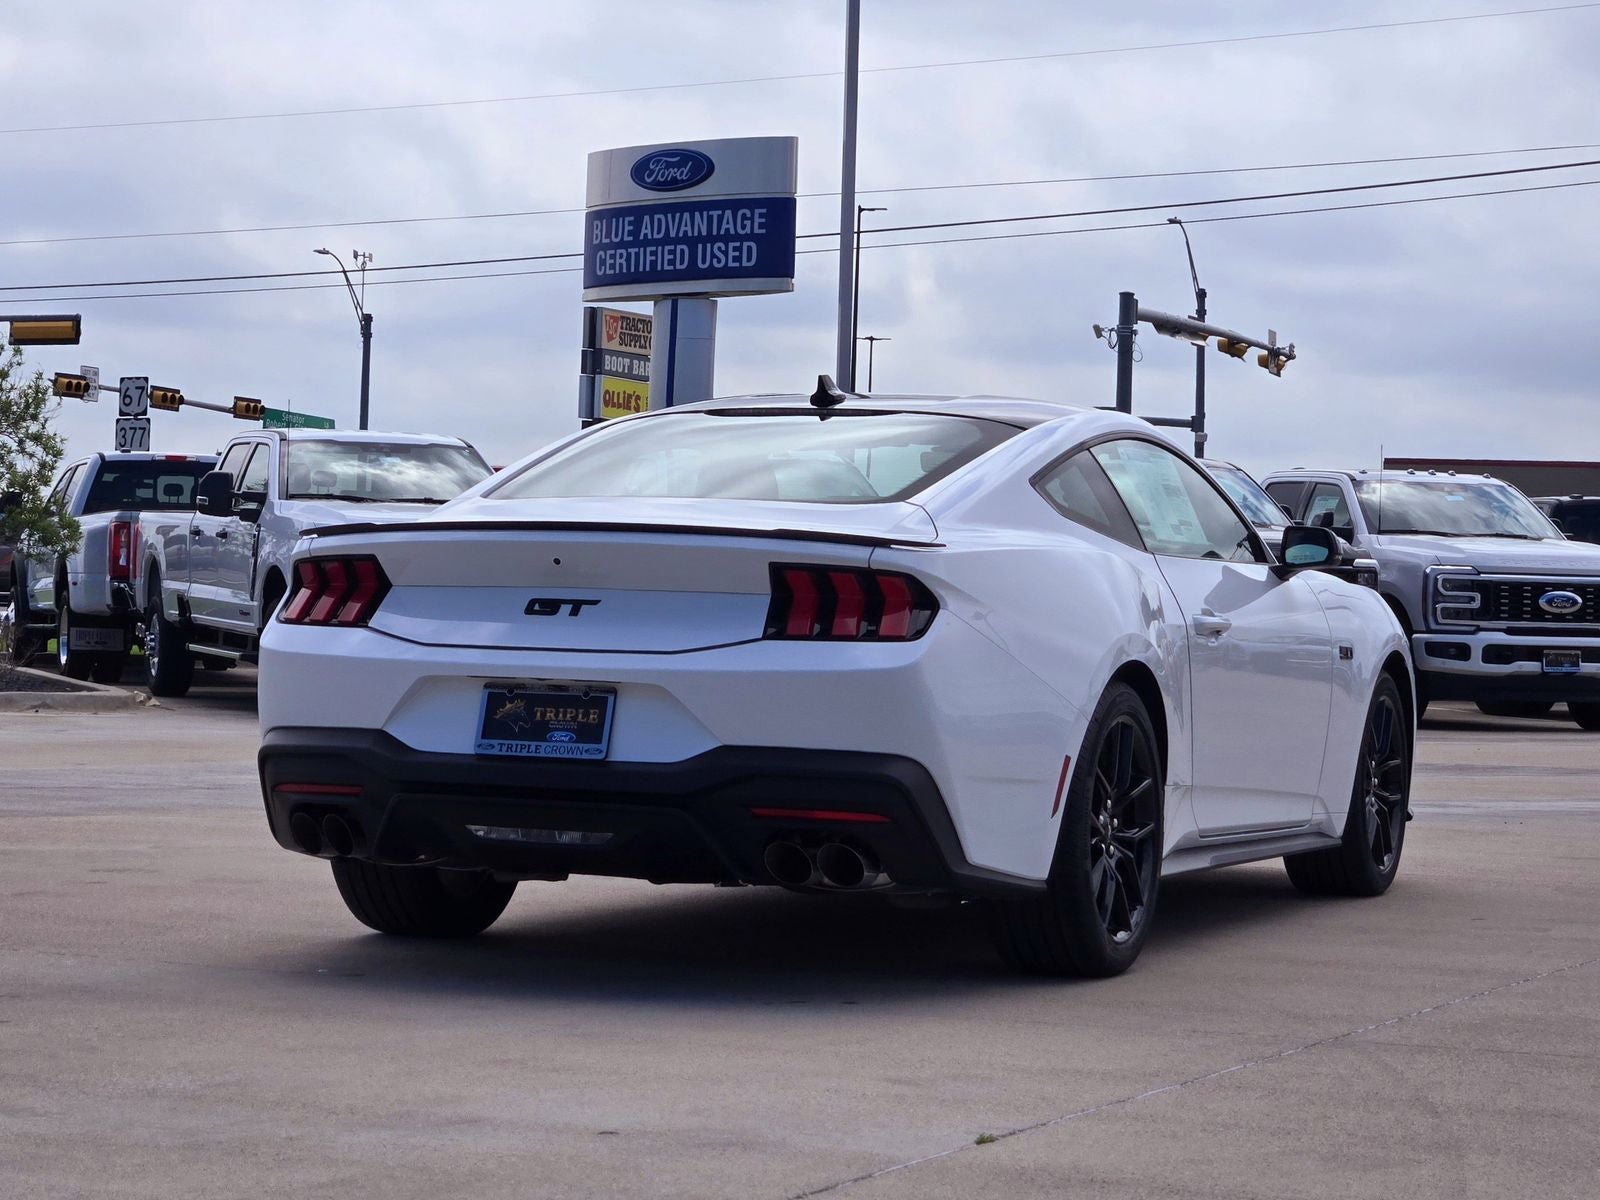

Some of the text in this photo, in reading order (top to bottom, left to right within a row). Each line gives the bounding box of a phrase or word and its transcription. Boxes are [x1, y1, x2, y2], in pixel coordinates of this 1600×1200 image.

[644, 156, 692, 182] Ford
[593, 208, 768, 245] BLUE ADVANTAGE
[596, 241, 757, 276] CERTIFIED USED
[619, 331, 648, 349] SUPPLY
[604, 354, 631, 374] BOOT
[122, 385, 145, 407] 67
[282, 412, 305, 424] Senator
[119, 426, 147, 448] 377
[523, 597, 602, 617] GT
[534, 707, 599, 723] TRIPLE
[497, 742, 542, 754] TRIPLE
[543, 744, 583, 756] CROWN
